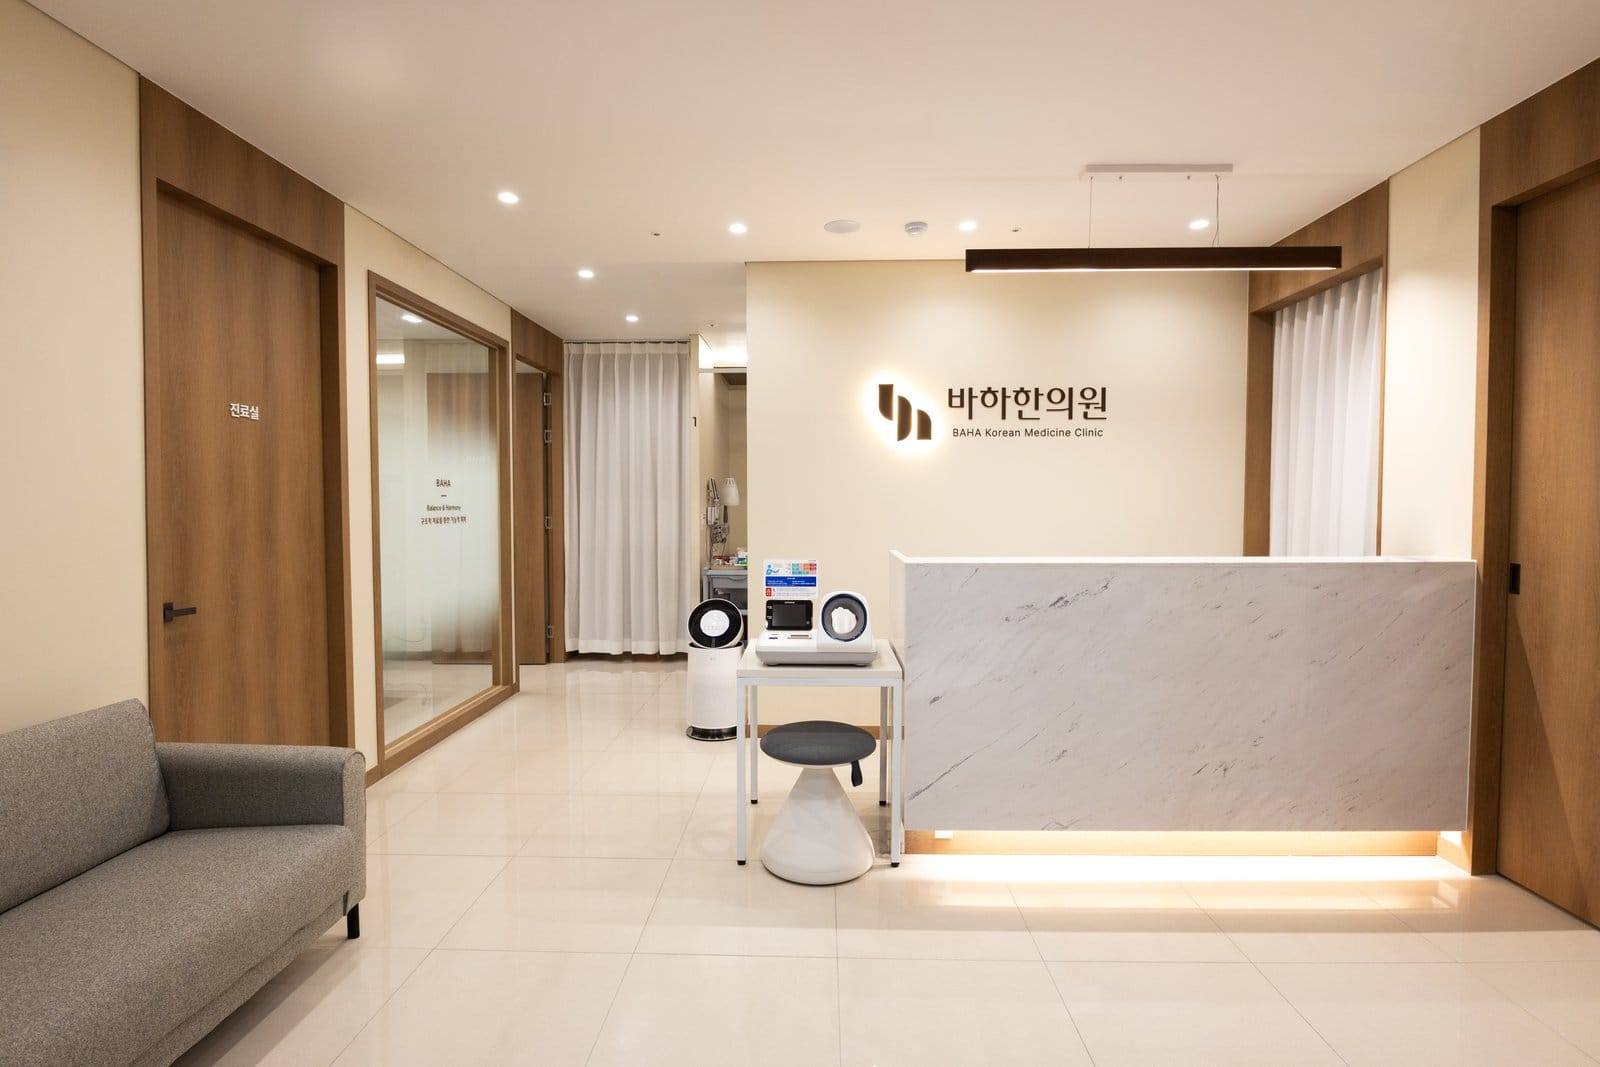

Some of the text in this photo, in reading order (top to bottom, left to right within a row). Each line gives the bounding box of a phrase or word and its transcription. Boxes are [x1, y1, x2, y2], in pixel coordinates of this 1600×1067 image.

[948, 386, 1107, 421] 바하한의원
[230, 403, 259, 420] 진료실
[952, 428, 1104, 438] BAHA Korean Medicine Clinic
[436, 478, 451, 488] BAHA
